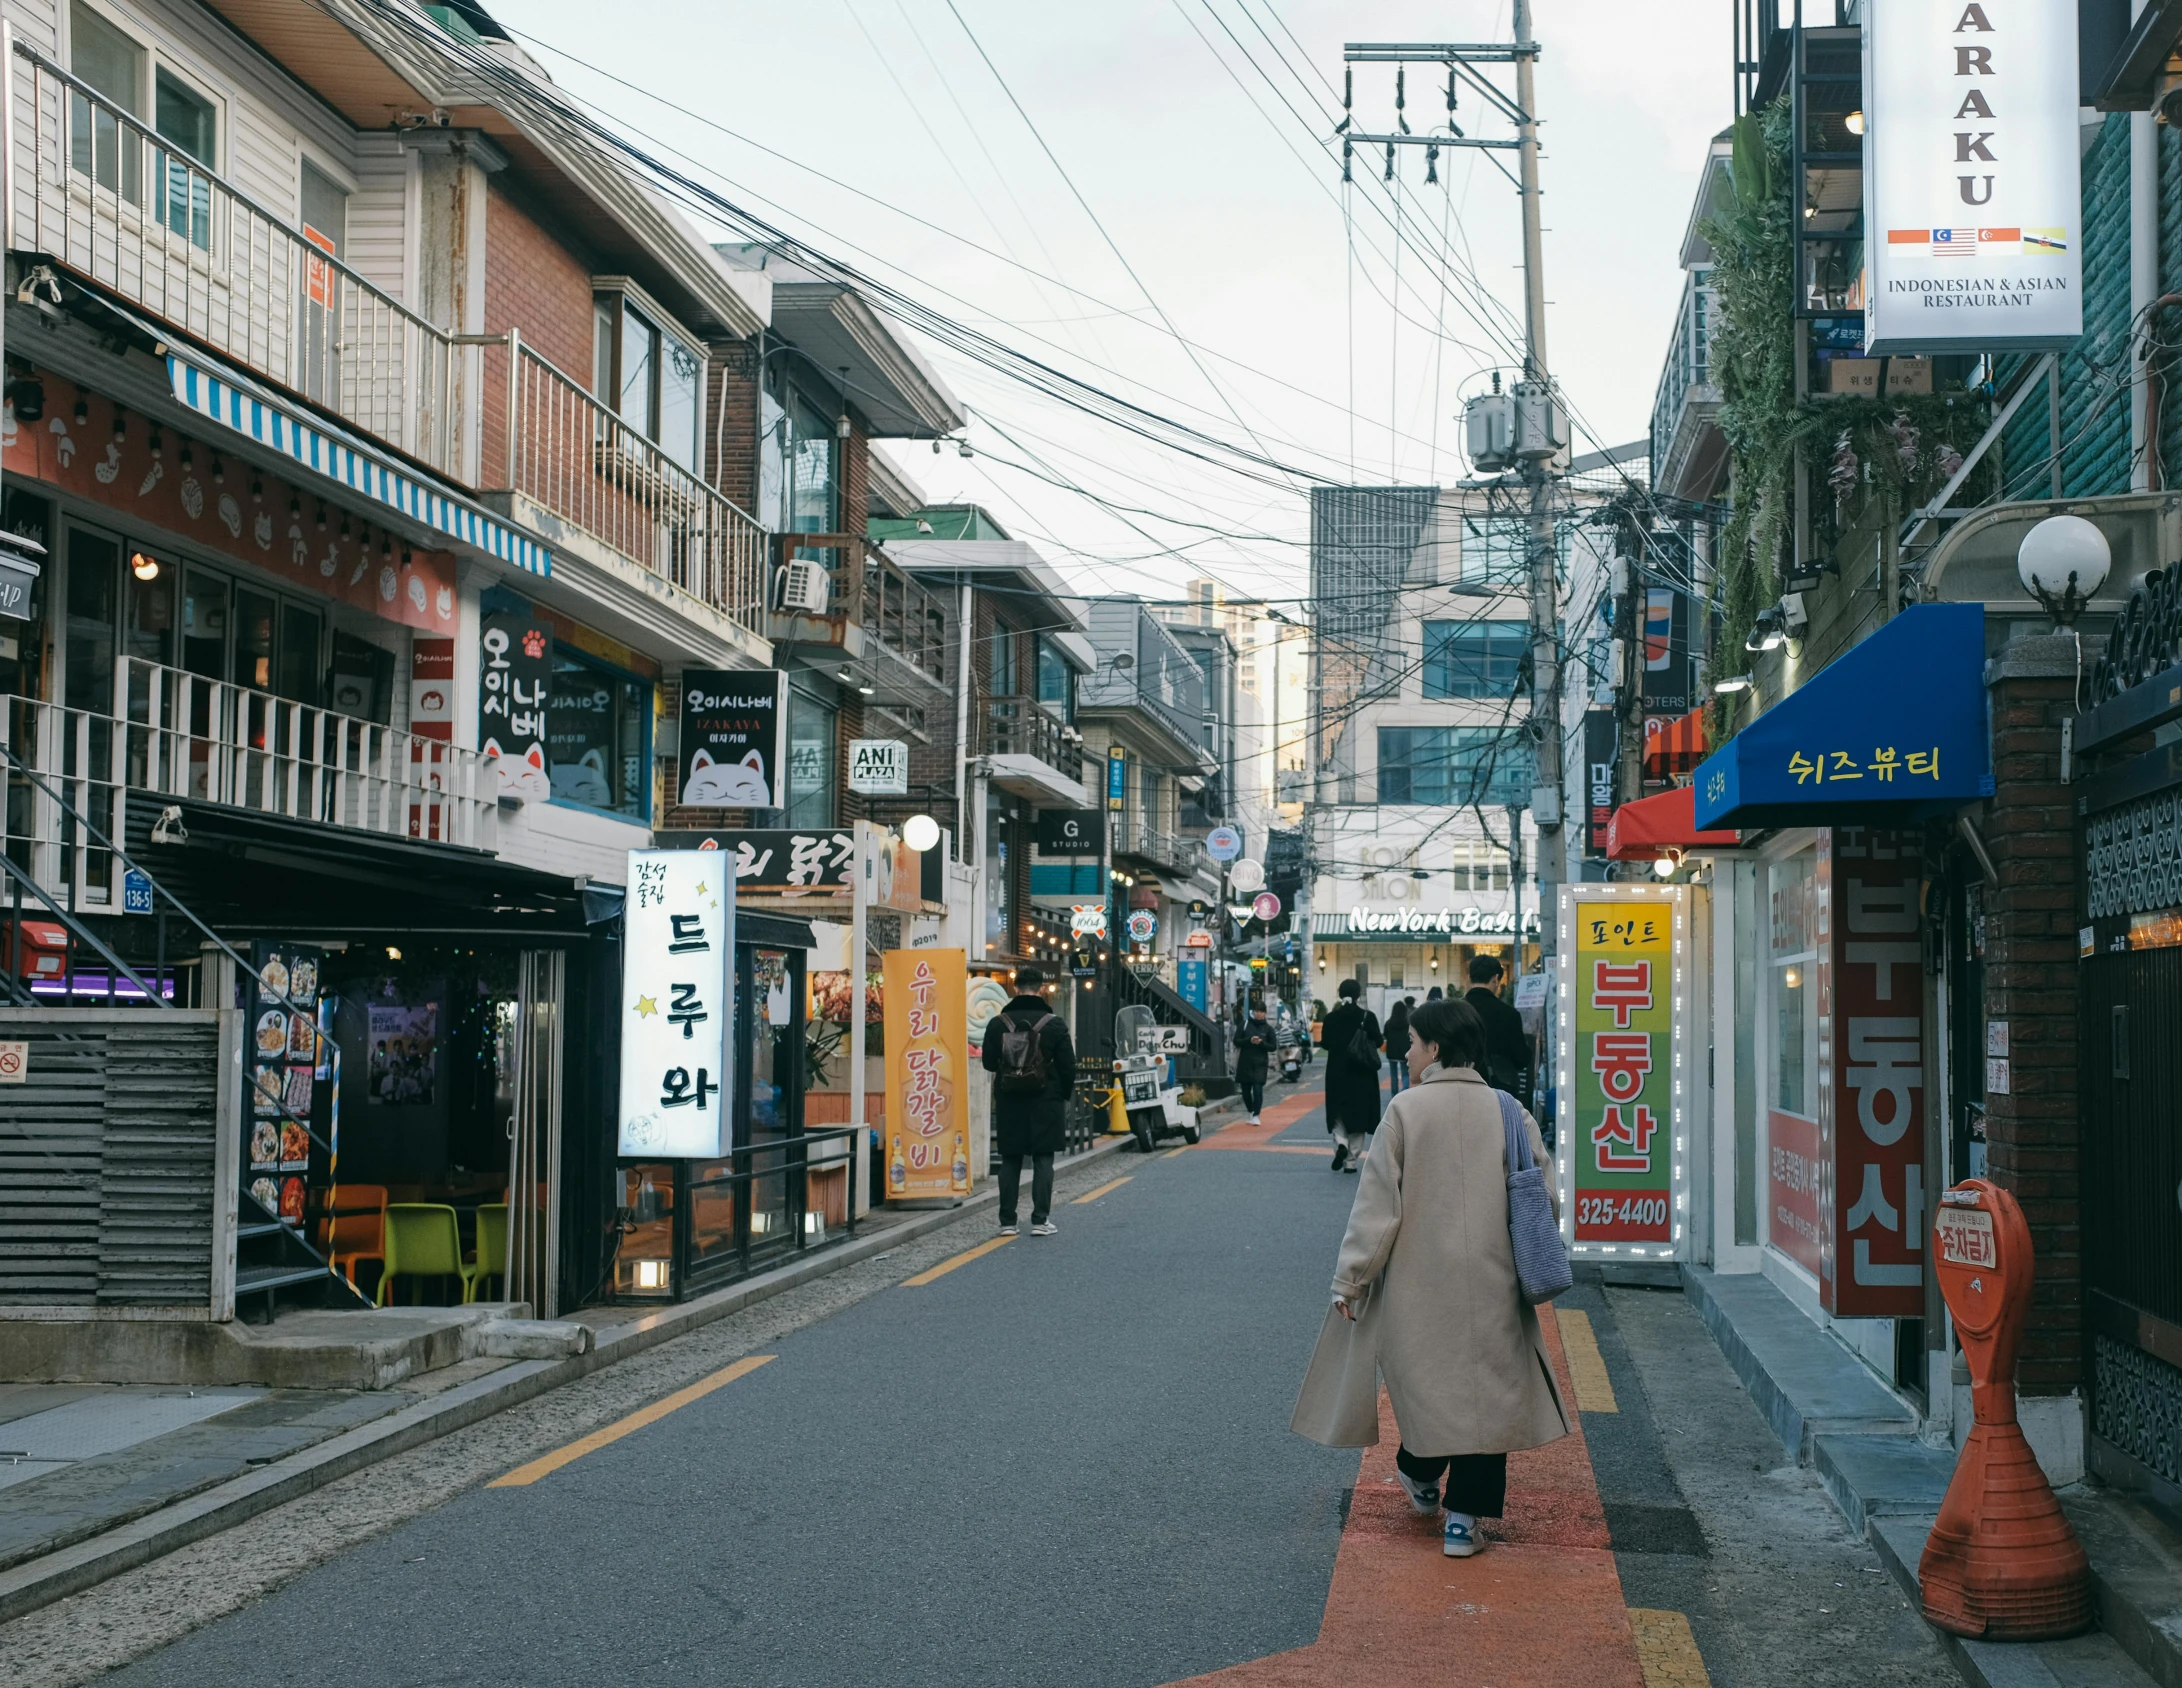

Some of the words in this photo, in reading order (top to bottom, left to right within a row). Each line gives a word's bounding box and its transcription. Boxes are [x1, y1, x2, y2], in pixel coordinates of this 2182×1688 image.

[1888, 279, 1995, 293] INDONESIAN
[1999, 280, 2012, 291] &
[2015, 277, 2068, 291] ASIAN
[1923, 293, 2033, 309] RESTAURANT
[688, 689, 772, 712] 오이시나베
[1645, 696, 1685, 708] OTERS
[697, 718, 761, 731] IZAKAYA
[709, 732, 748, 744] 이자카야
[857, 748, 892, 764] ANI
[855, 767, 894, 779] PLAZA
[1064, 820, 1079, 837] G
[1052, 840, 1090, 848] STUDIO
[635, 863, 668, 880] 감성
[637, 884, 665, 908] 술집
[1359, 877, 1422, 901] SALON
[127, 890, 150, 908] 136-5
[1591, 920, 1660, 945] 포인트
[1129, 963, 1161, 974] TERRA
[908, 960, 940, 1040] 우리
[660, 914, 719, 1111] 드루와
[1592, 960, 1657, 1174] 부동산
[1844, 877, 1925, 1288] 부동산
[905, 1048, 945, 1169] 닭갈비
[1577, 1197, 1668, 1228] 325-4400
[1942, 1225, 1993, 1263] 주차금지
